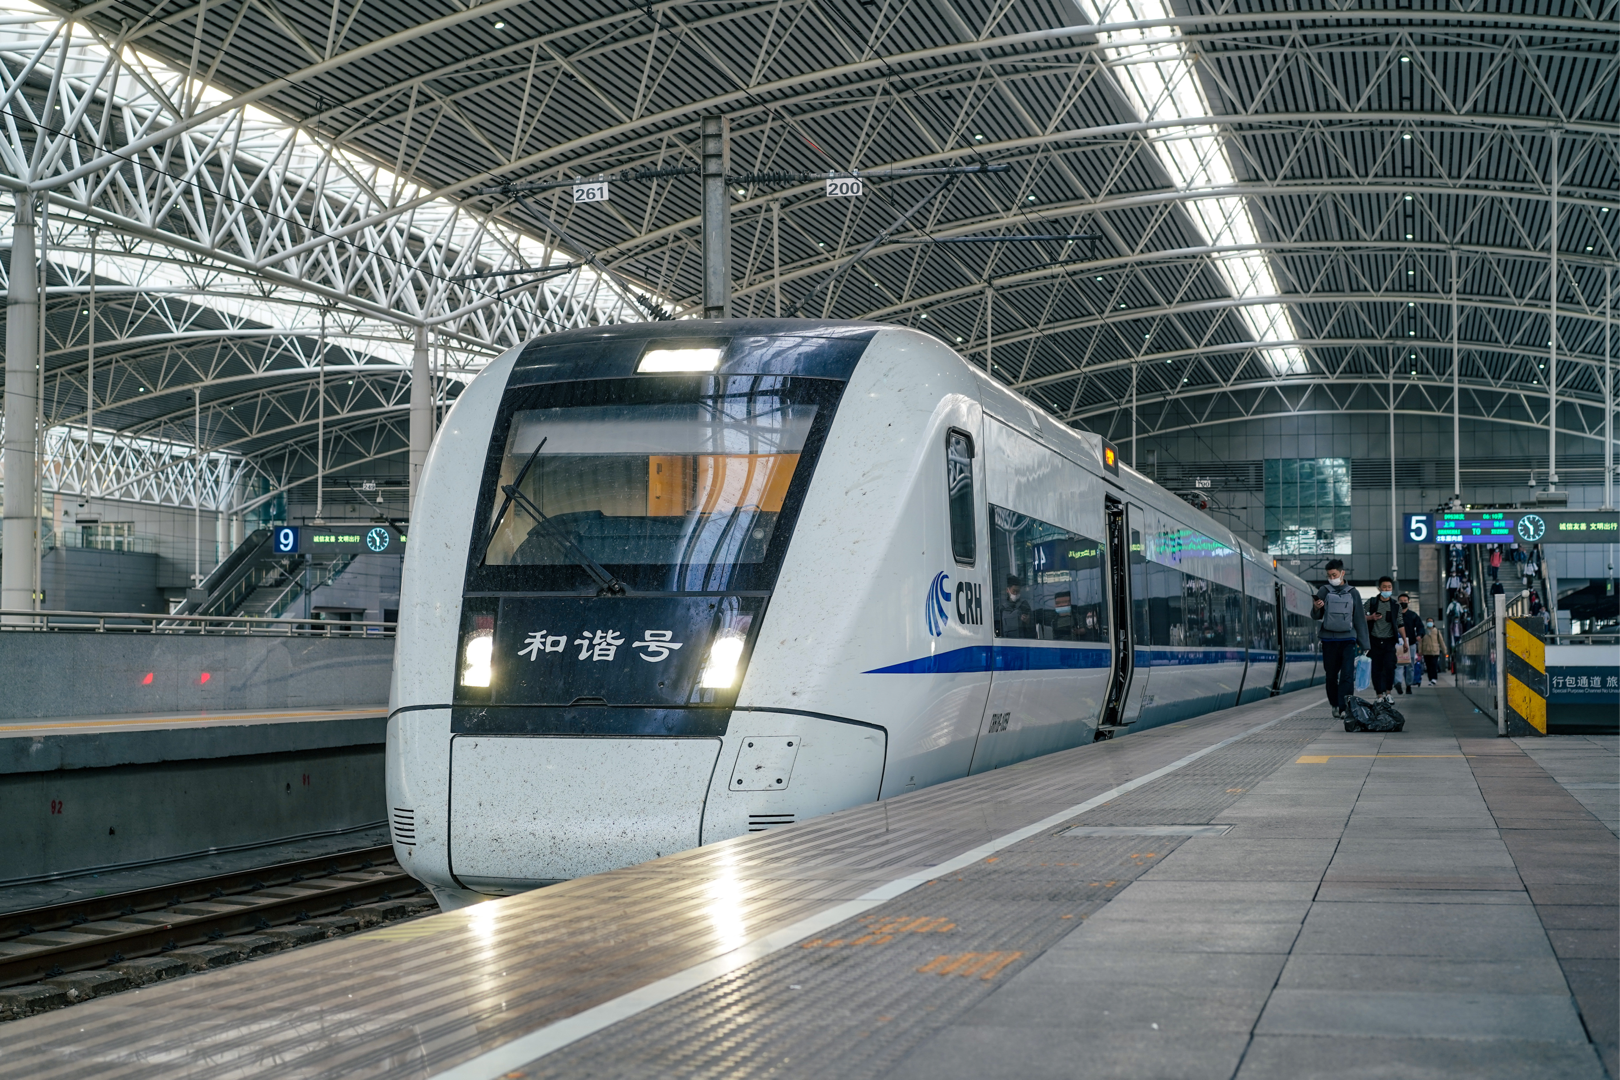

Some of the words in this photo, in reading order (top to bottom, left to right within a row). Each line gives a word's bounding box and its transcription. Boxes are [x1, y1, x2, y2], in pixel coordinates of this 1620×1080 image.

[575, 186, 604, 201] 261
[828, 182, 860, 195] 200
[1410, 515, 1428, 541] 5
[279, 528, 294, 551] 9
[955, 581, 983, 625] CRH
[517, 629, 684, 663] 和谐号
[1552, 676, 1601, 688] 行包通道
[1606, 676, 1620, 688] 旅
[51, 799, 63, 815] 92
